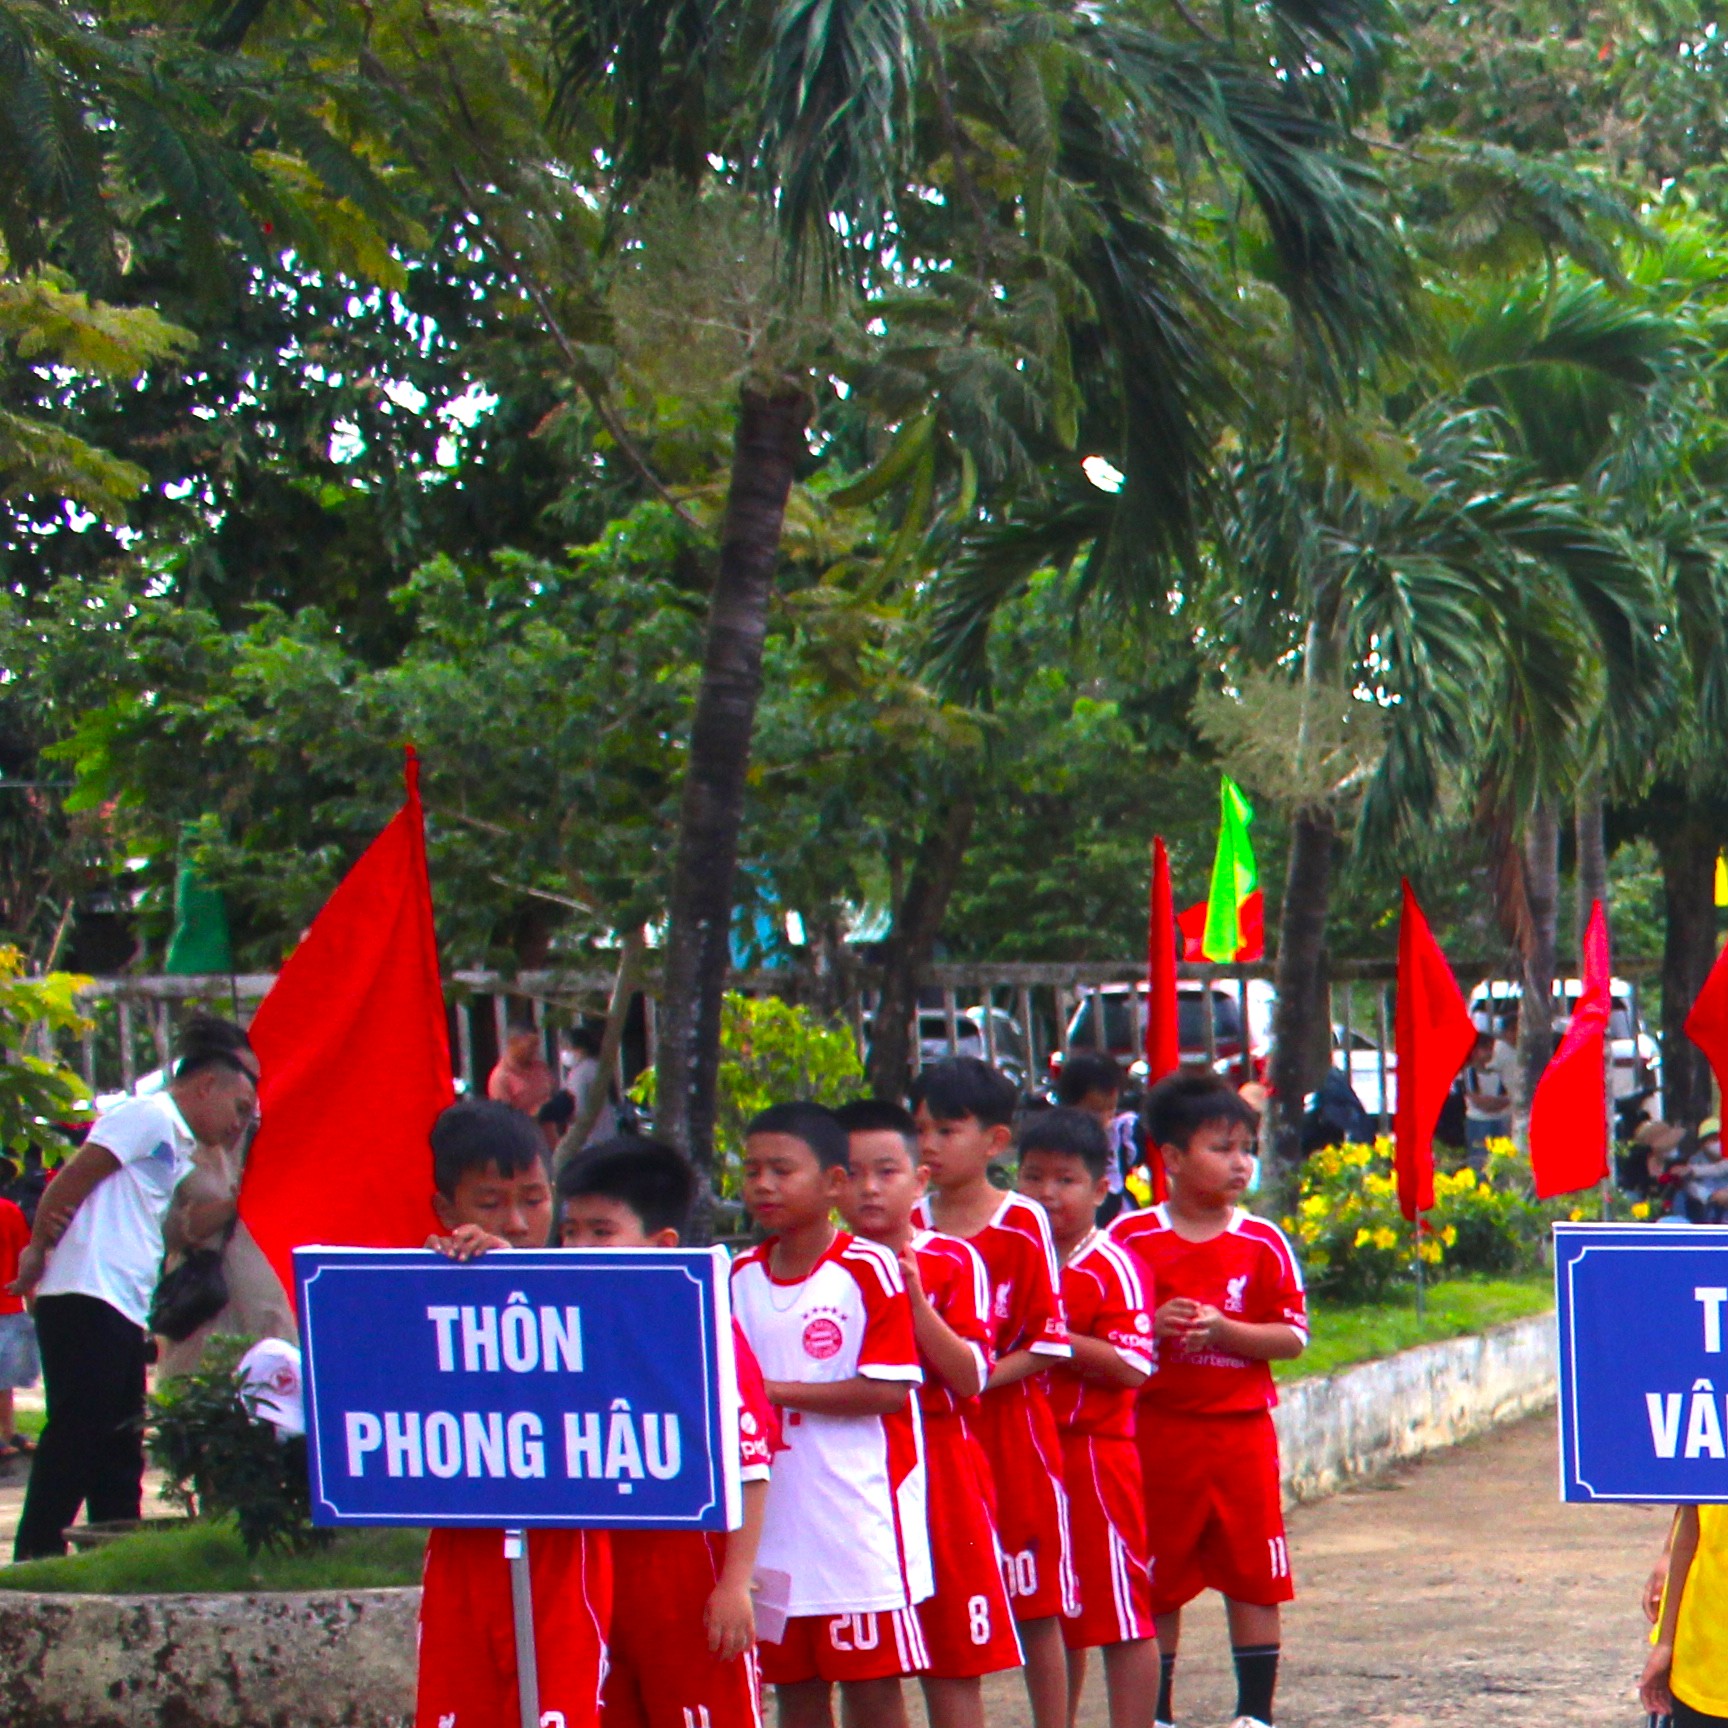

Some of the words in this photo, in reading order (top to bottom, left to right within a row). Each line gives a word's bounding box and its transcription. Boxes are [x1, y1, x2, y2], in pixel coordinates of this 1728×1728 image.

[428, 1292, 583, 1372] THÔN
[346, 1412, 545, 1478] PHONG
[564, 1398, 681, 1494] HẬU
[829, 1613, 879, 1650] 20
[968, 1595, 990, 1645] 8
